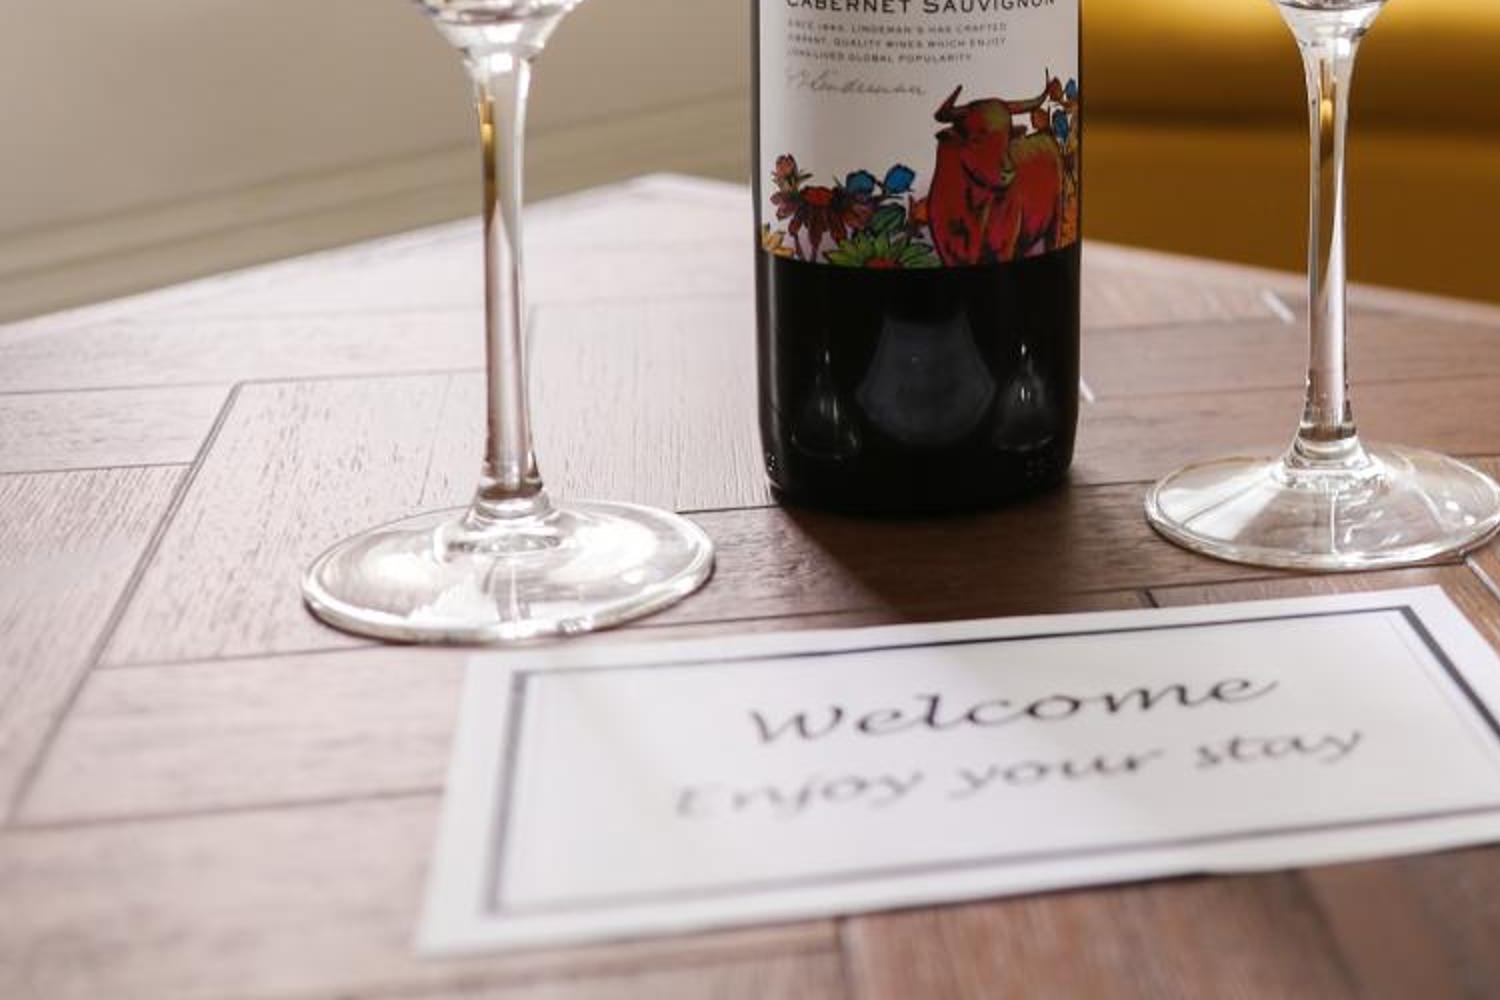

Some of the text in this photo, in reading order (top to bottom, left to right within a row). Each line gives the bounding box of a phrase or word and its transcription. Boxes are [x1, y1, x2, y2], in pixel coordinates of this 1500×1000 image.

[750, 677, 1280, 745] Welcome
[674, 728, 1364, 822] Enjoy your stay
